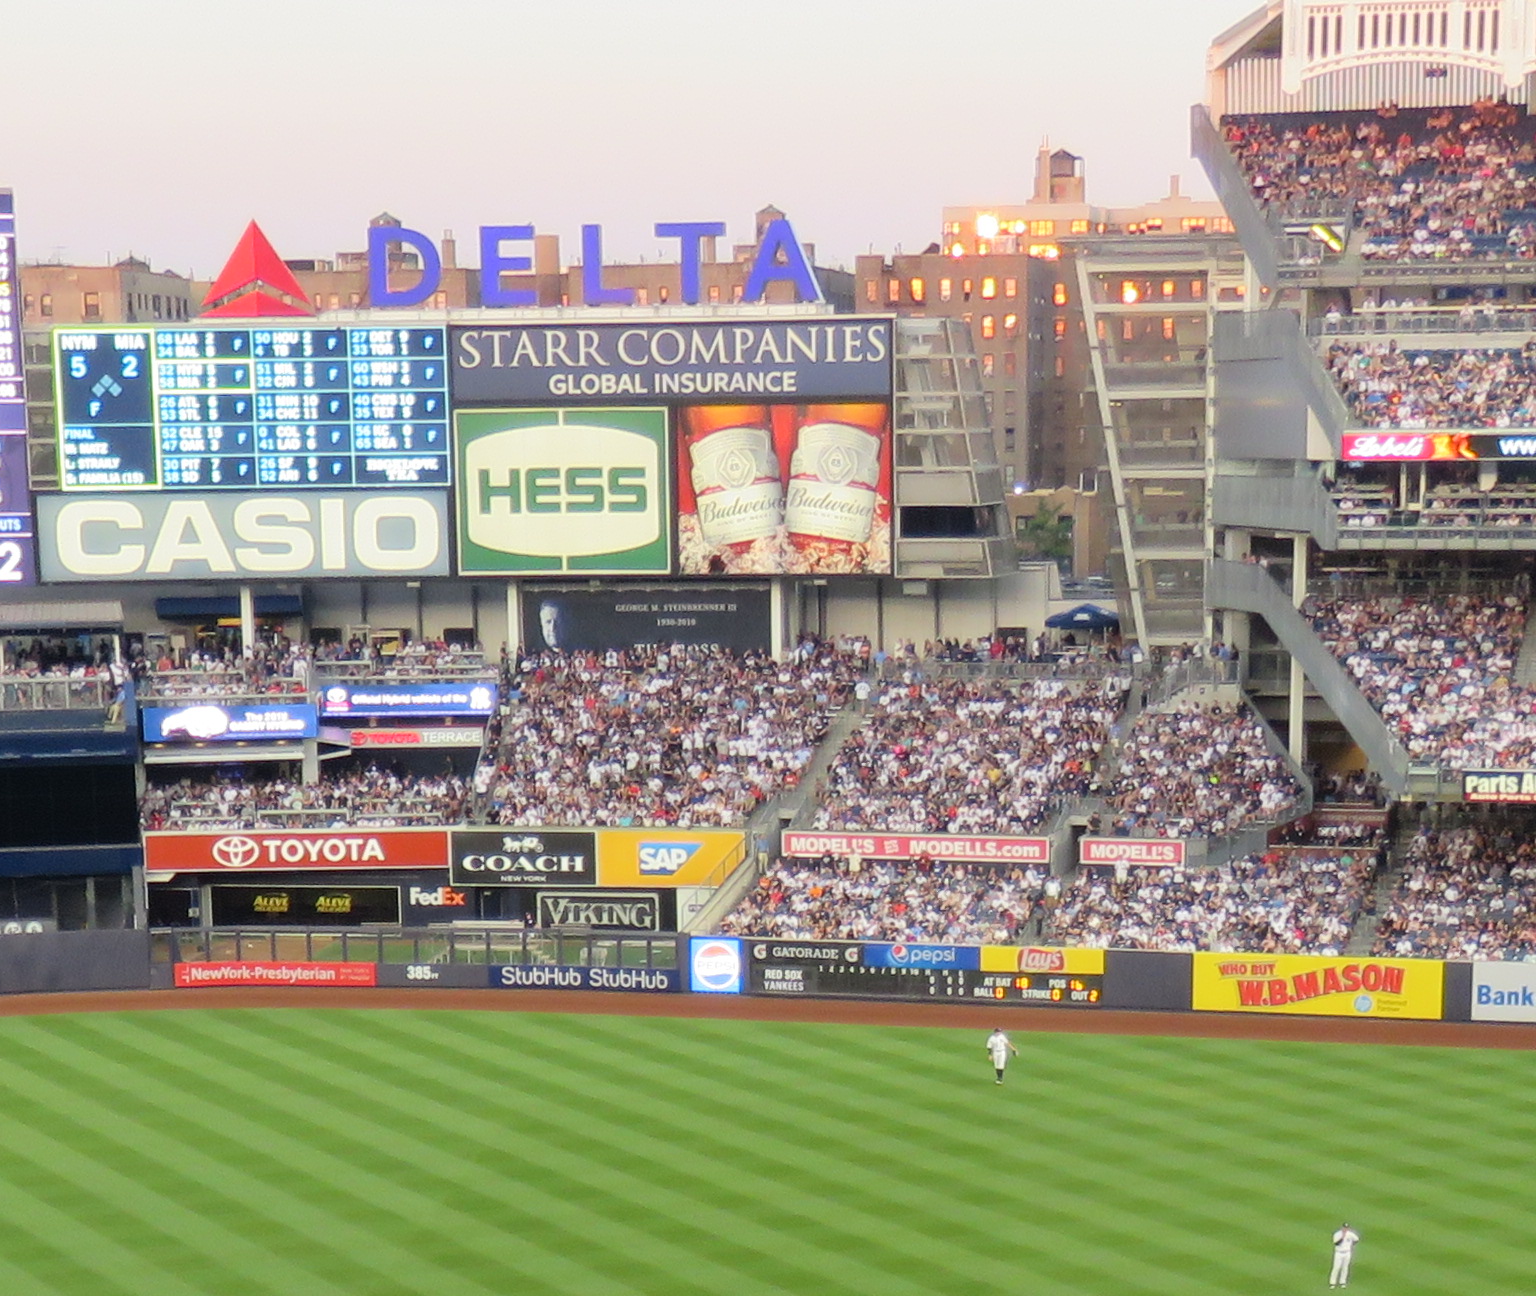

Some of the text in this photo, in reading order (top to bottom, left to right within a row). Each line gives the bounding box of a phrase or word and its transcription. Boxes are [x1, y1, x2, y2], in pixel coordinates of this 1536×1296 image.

[367, 219, 825, 308] DELTA
[61, 334, 146, 350] NYM MIA
[459, 325, 887, 369] STARR COMPANIES
[70, 355, 139, 378] 5 2
[549, 370, 798, 396] GLOBAL INSURANCE
[477, 466, 648, 514] HESS
[56, 497, 440, 576] CASIO
[366, 731, 481, 745] TOYOTA TERRACE
[1465, 775, 1519, 794] Parts
[262, 838, 385, 862] TOYOTA
[790, 837, 874, 854] MODELL'S
[909, 840, 1040, 858] MODELLS.com
[1090, 844, 1175, 860] MODELL'S
[462, 855, 585, 873] COACH
[639, 847, 689, 871] SAP
[500, 875, 547, 883] NEW YORK
[409, 887, 465, 906] FedEx
[543, 898, 656, 929] VIKING
[772, 946, 839, 960] GATORADE
[910, 947, 956, 966] pepsi
[697, 960, 736, 972] PEPSI
[765, 968, 803, 981] RED SOX
[1218, 963, 1276, 976] WHO BUT
[501, 966, 669, 990] StubHub StubHub
[763, 980, 805, 992] YANKEES
[983, 978, 1012, 988] AT BAT
[974, 987, 994, 998] BALL
[1022, 989, 1051, 999] STRIKE
[1071, 991, 1089, 1001] OUT
[1477, 984, 1533, 1006] Bank
